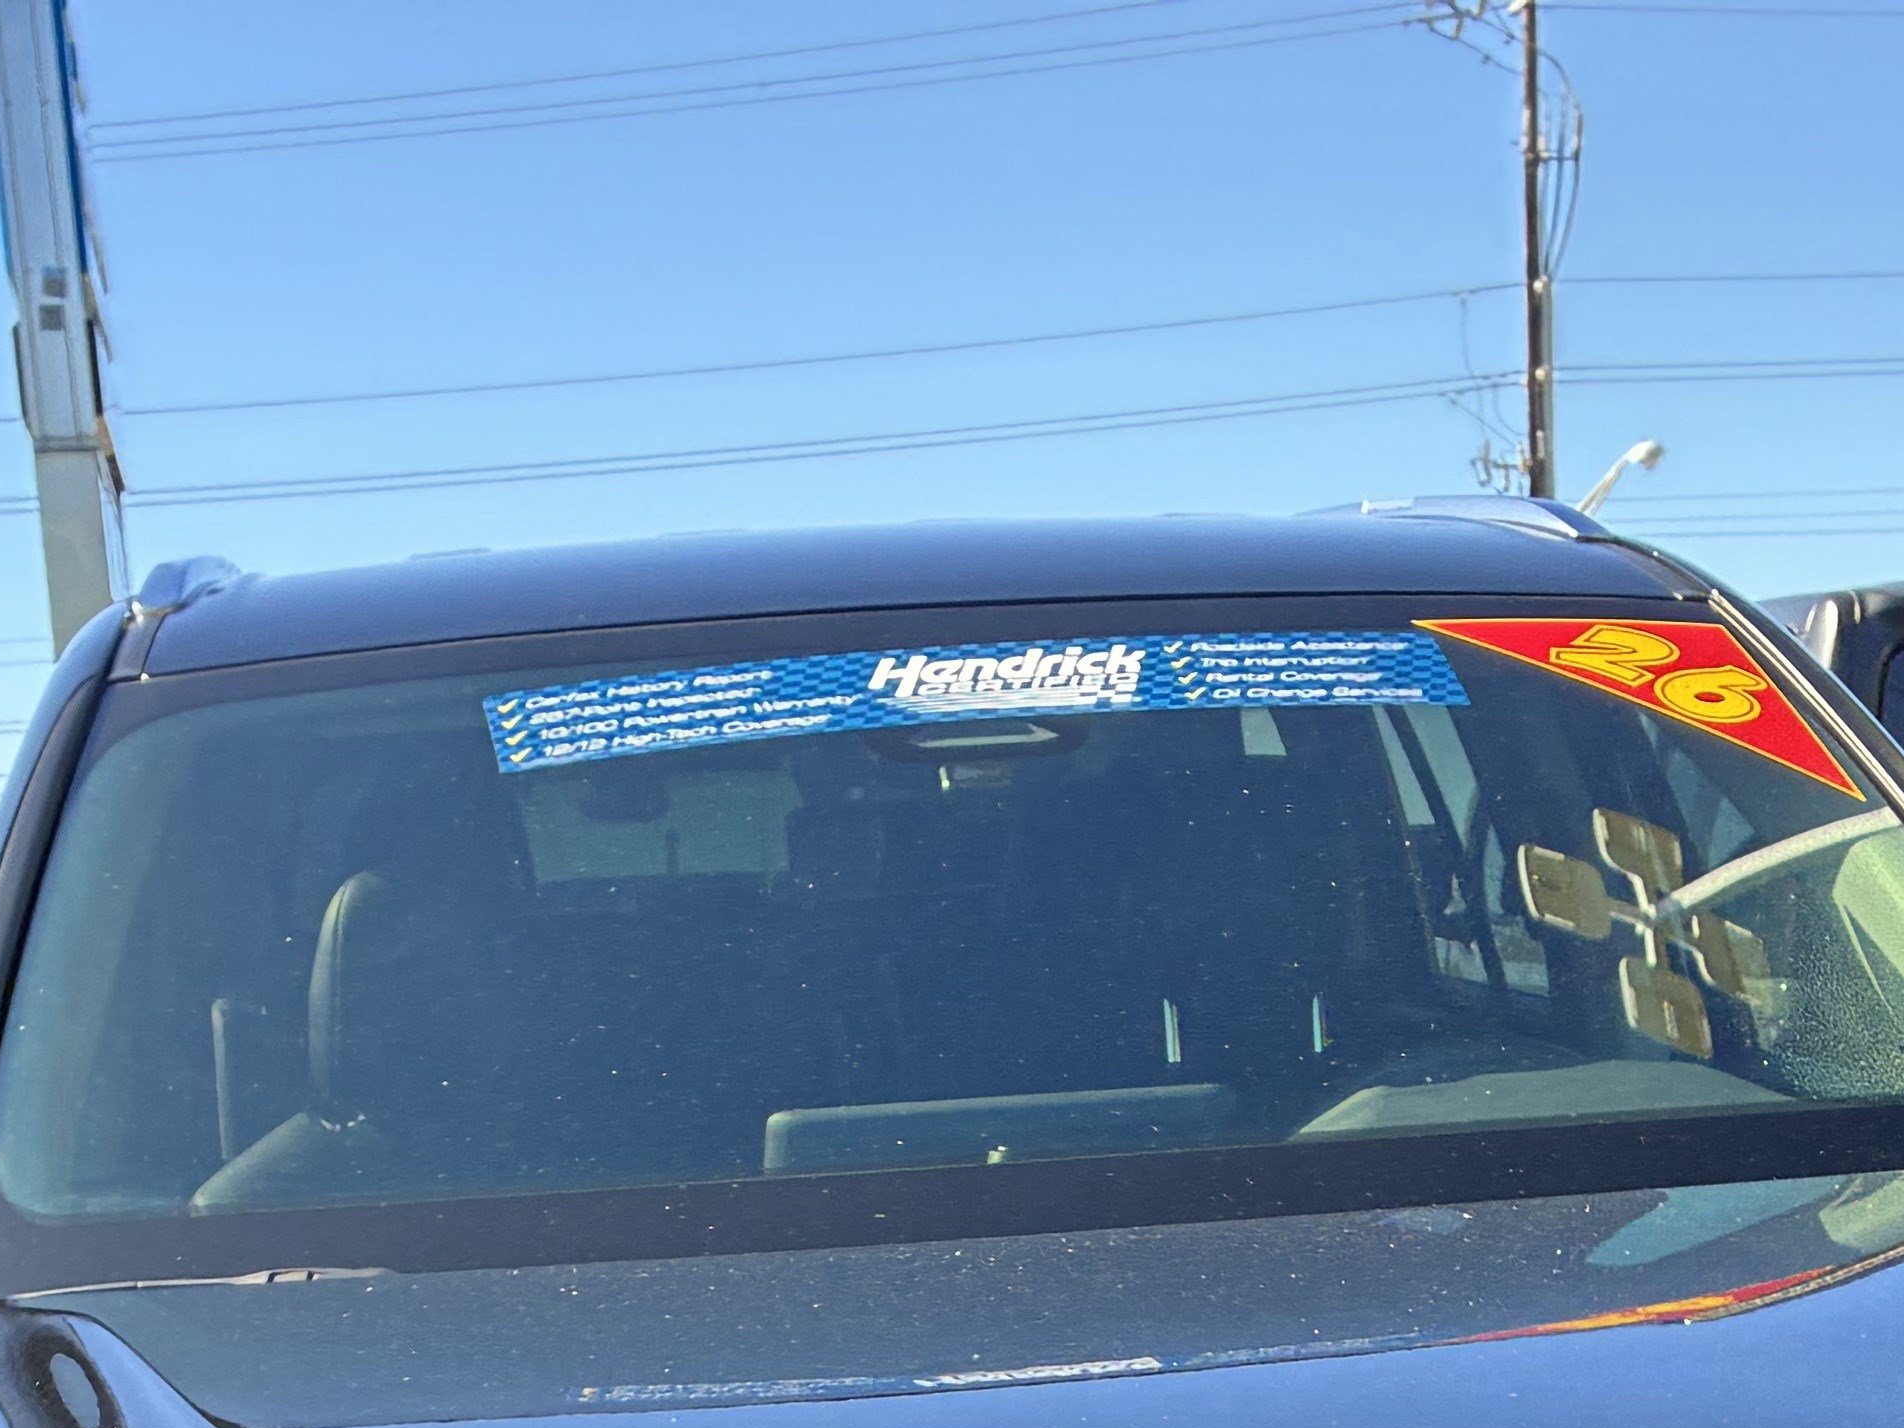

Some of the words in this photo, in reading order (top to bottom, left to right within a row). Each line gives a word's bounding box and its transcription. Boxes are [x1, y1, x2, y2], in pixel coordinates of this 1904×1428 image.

[1190, 642, 1286, 652] Roadside
[1290, 641, 1408, 650] Assistance
[1201, 657, 1240, 667] Trip
[1243, 656, 1369, 666] Interruption
[868, 645, 1146, 698] Hendrick
[1205, 672, 1275, 683] Rental
[1280, 671, 1383, 683] Coverage
[1550, 624, 1769, 723] 26
[525, 692, 600, 709] Carfax
[607, 681, 685, 697] History
[693, 670, 773, 686] Report
[1212, 688, 1242, 699] Oil
[1246, 687, 1329, 698] Change
[1331, 686, 1424, 697] Services
[623, 706, 748, 728] Powertrain
[753, 695, 862, 713] Warranty
[612, 725, 718, 747] High-Tech
[722, 714, 831, 737] Coverage
